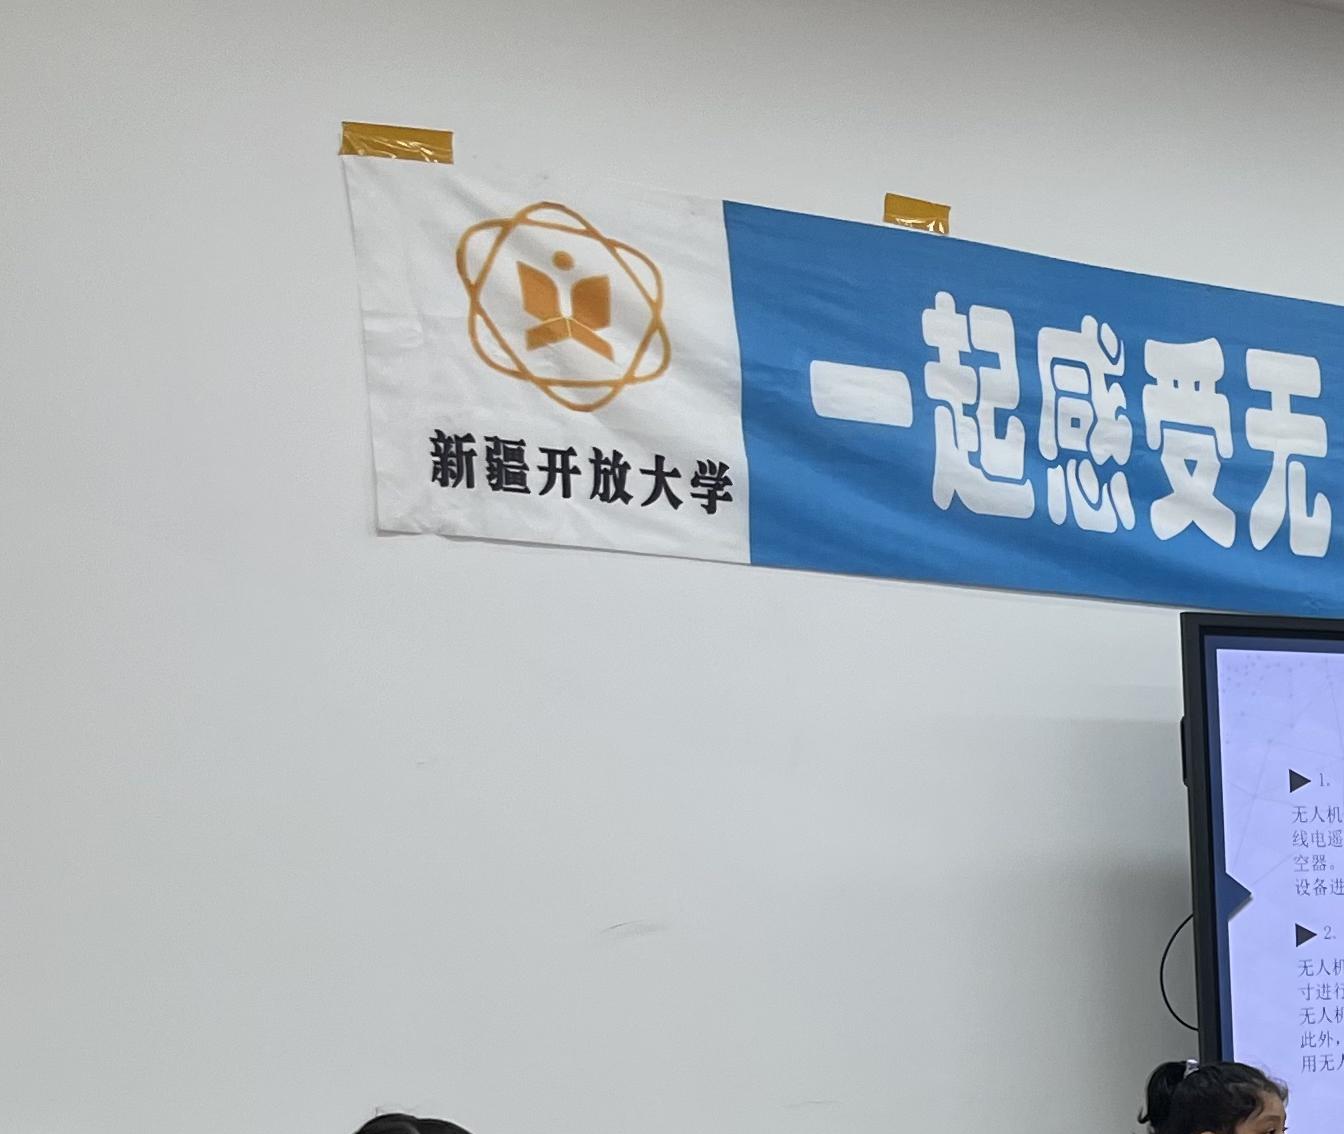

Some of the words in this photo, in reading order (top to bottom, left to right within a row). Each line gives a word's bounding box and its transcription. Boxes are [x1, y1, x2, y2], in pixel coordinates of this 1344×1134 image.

[429, 428, 734, 515] 新疆开放大学
